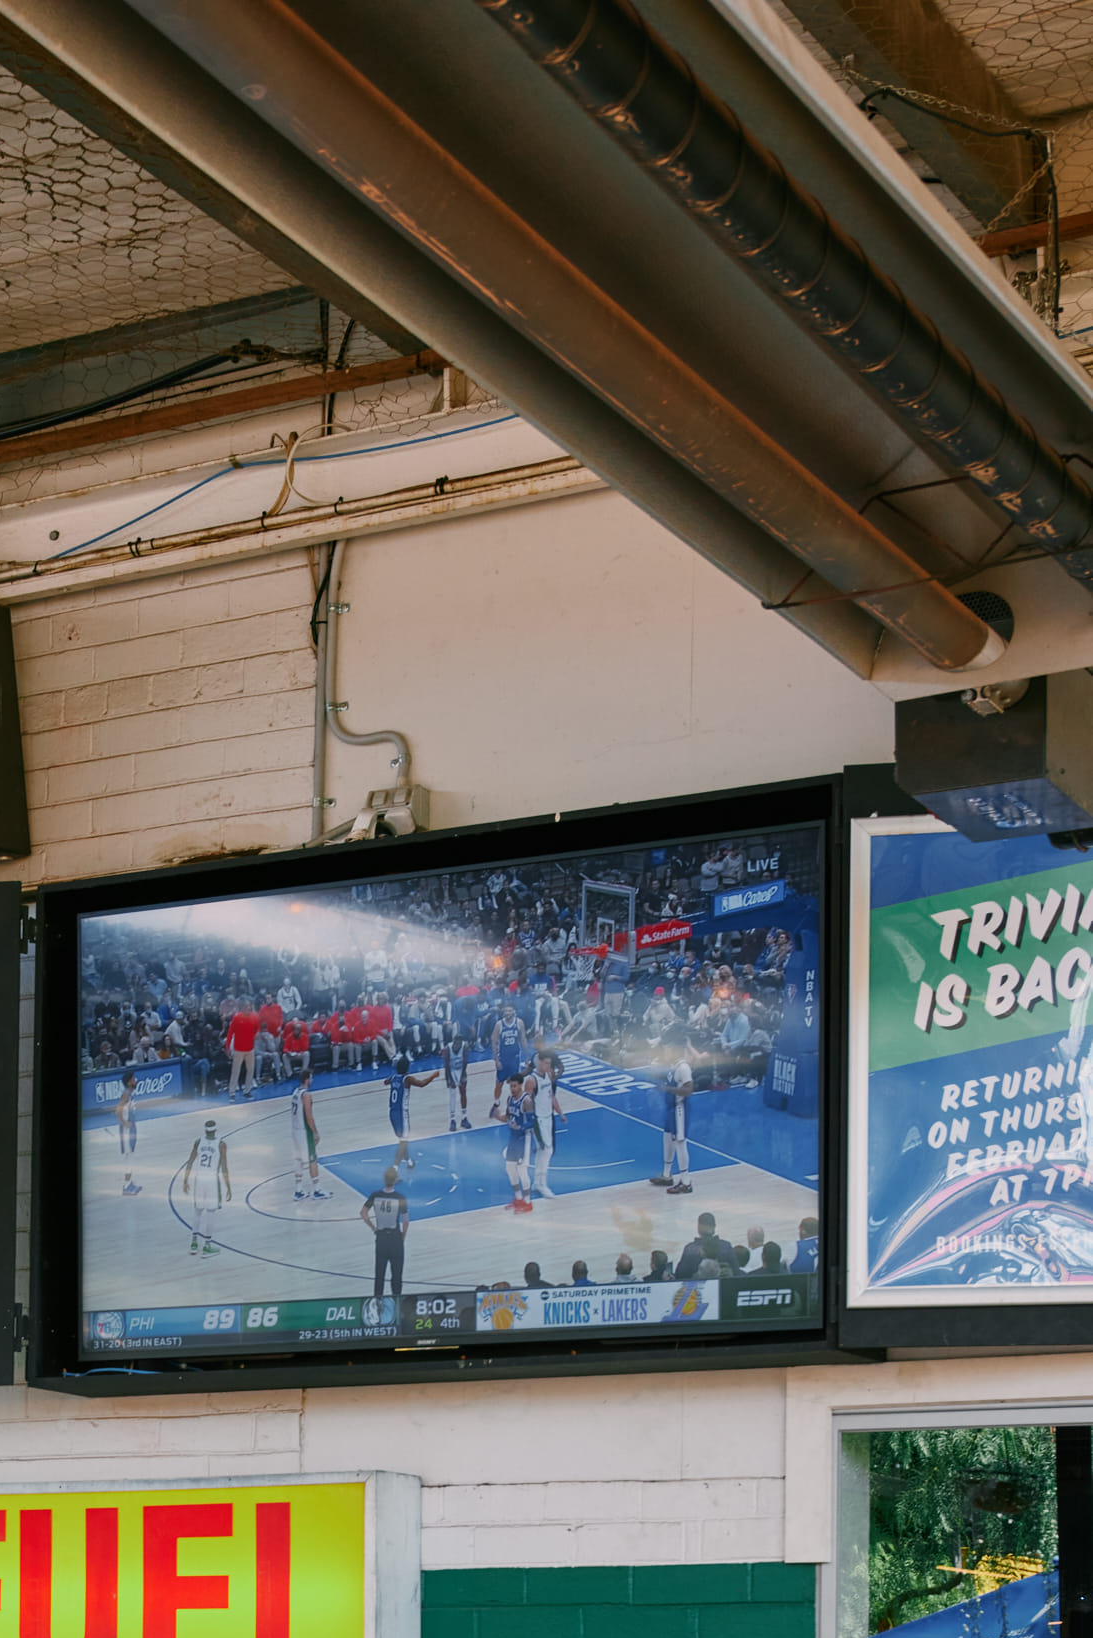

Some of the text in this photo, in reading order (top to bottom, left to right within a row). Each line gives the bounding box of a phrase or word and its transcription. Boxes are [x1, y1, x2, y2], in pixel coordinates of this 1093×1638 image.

[747, 857, 779, 872] LIVE
[914, 947, 1093, 1034] IS BAC
[131, 1077, 165, 1096] ares
[927, 1092, 1084, 1149] ON THURS
[200, 1154, 212, 1168] 21
[990, 1174, 1029, 1206] AT
[936, 1234, 1026, 1254] BOOKINGS
[552, 1289, 599, 1299] SATURDAY
[601, 1286, 652, 1296] PRIMETIME
[736, 1289, 792, 1307] ESPN
[416, 1299, 456, 1315] 8:02
[543, 1300, 590, 1325] KNICKS
[602, 1297, 647, 1322] LAKERS
[129, 1316, 155, 1331] PHI
[203, 1309, 235, 1330] 89
[246, 1306, 356, 1328] 86 DAL
[415, 1317, 460, 1330] 24 4th
[299, 1326, 397, 1340] 29-23 (5th IN WEST)
[93, 1339, 121, 1349] 31-20
[153, 1336, 182, 1347] EAST)
